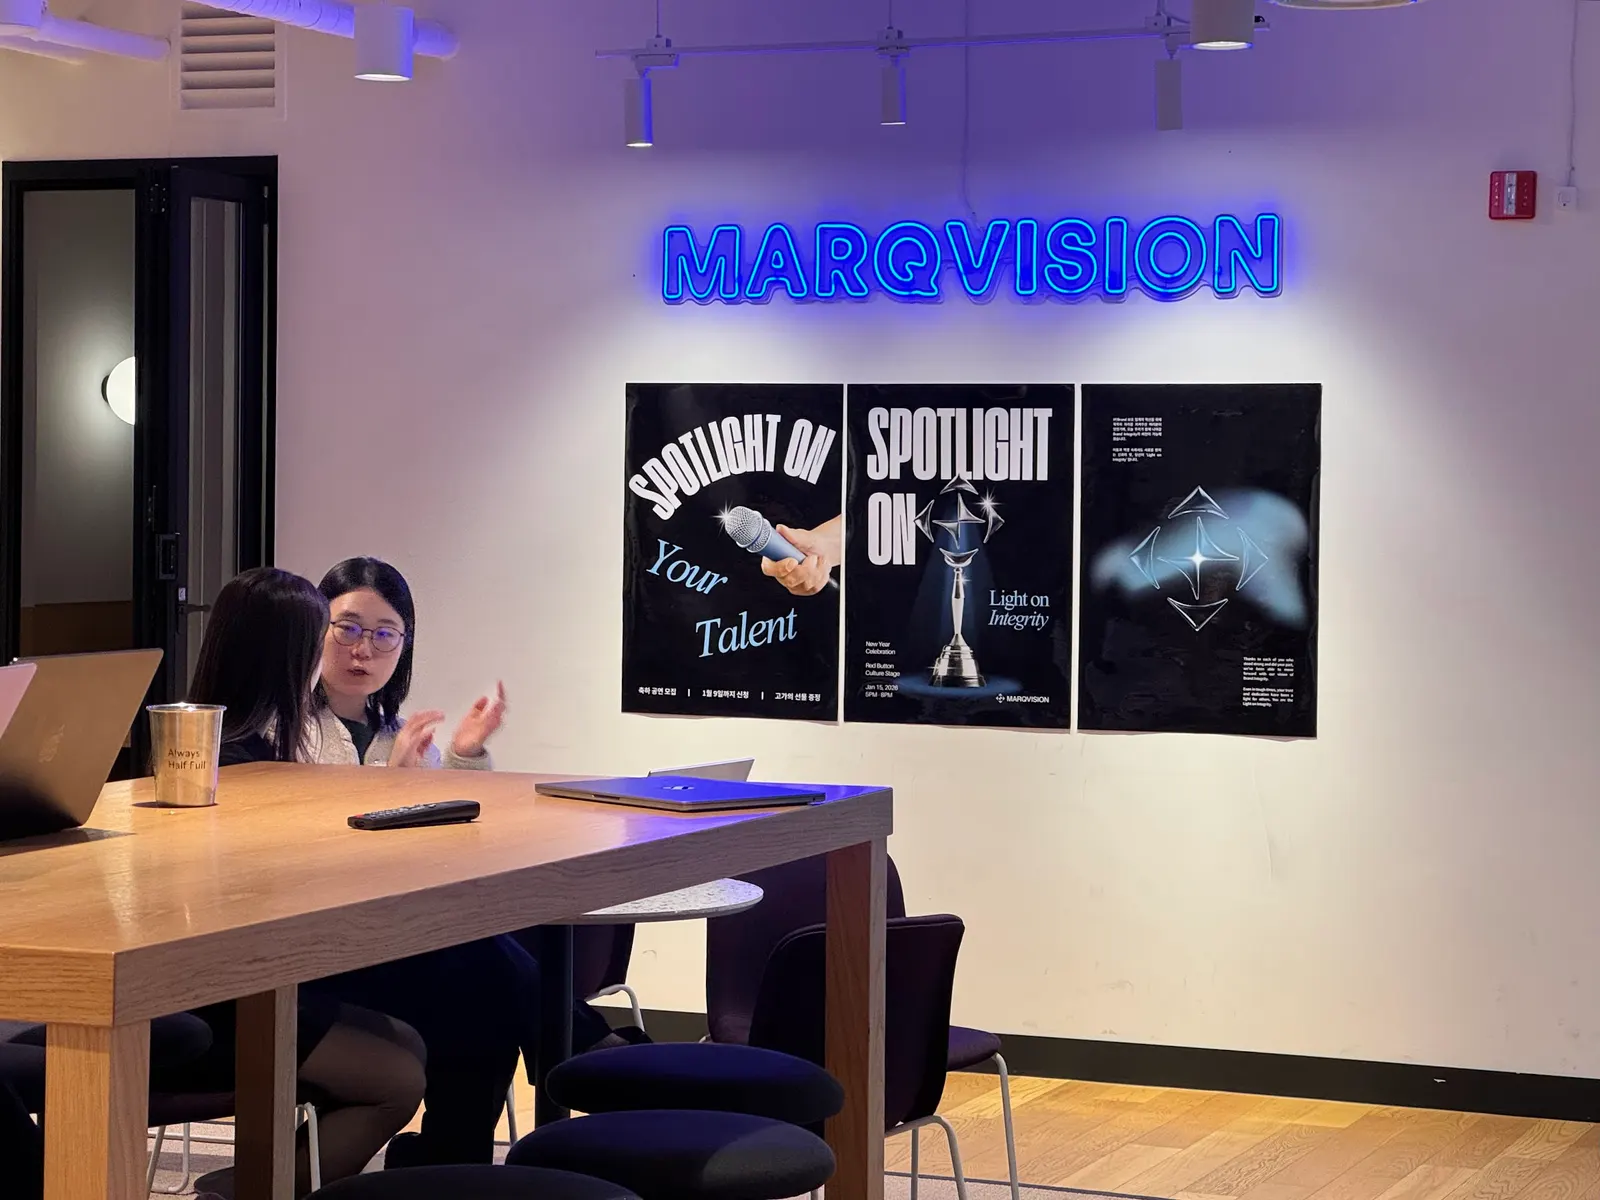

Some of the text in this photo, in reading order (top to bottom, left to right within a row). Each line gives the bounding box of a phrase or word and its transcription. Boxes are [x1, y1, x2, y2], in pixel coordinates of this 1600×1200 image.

[662, 214, 1281, 298] MARQVISION
[866, 406, 1053, 481] SPOTLIGHT
[628, 413, 836, 521] SPOTLIGHT ON
[867, 492, 916, 566] ON
[646, 538, 729, 596] Your
[989, 589, 1050, 611] Light on
[695, 607, 798, 658] Talent
[988, 609, 1049, 631] Integrity
[638, 686, 821, 702] 축하 공연 모집 1월 9일까지 신청 고가의 선물 증정
[1006, 695, 1050, 704] MARQVISION
[168, 748, 200, 758] Always
[168, 760, 206, 770] Half Full
